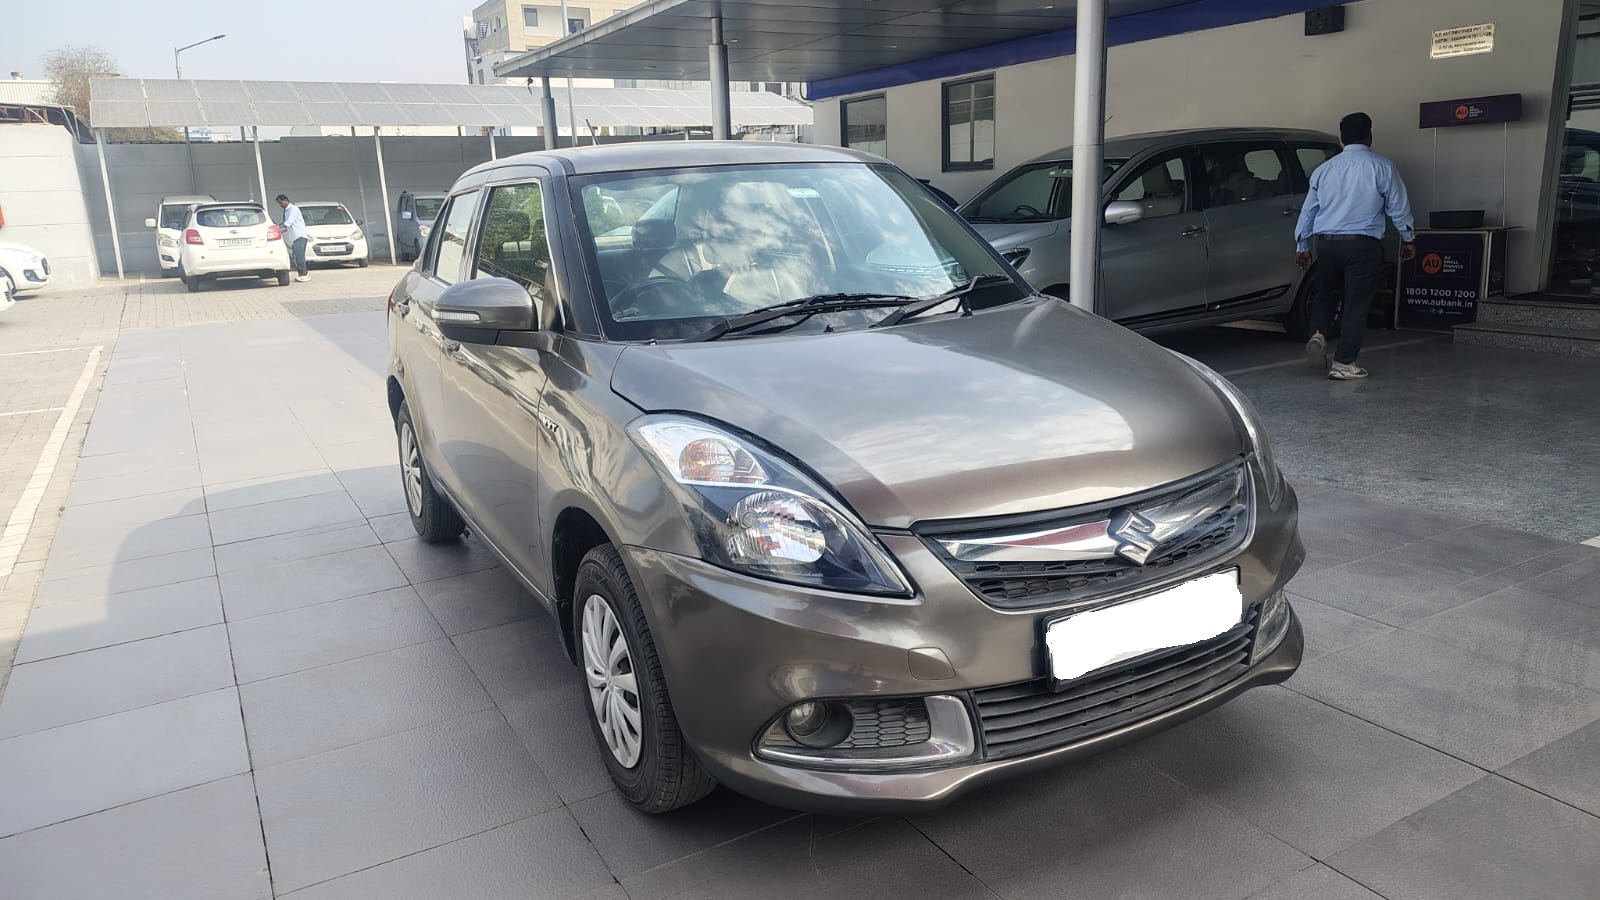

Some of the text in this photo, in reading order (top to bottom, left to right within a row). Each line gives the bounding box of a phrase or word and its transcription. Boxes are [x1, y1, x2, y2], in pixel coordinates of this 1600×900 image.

[1423, 258, 1440, 268] AU
[1406, 287, 1476, 298] 1800 1200 1200
[1407, 298, 1473, 308] www.aubank.in
